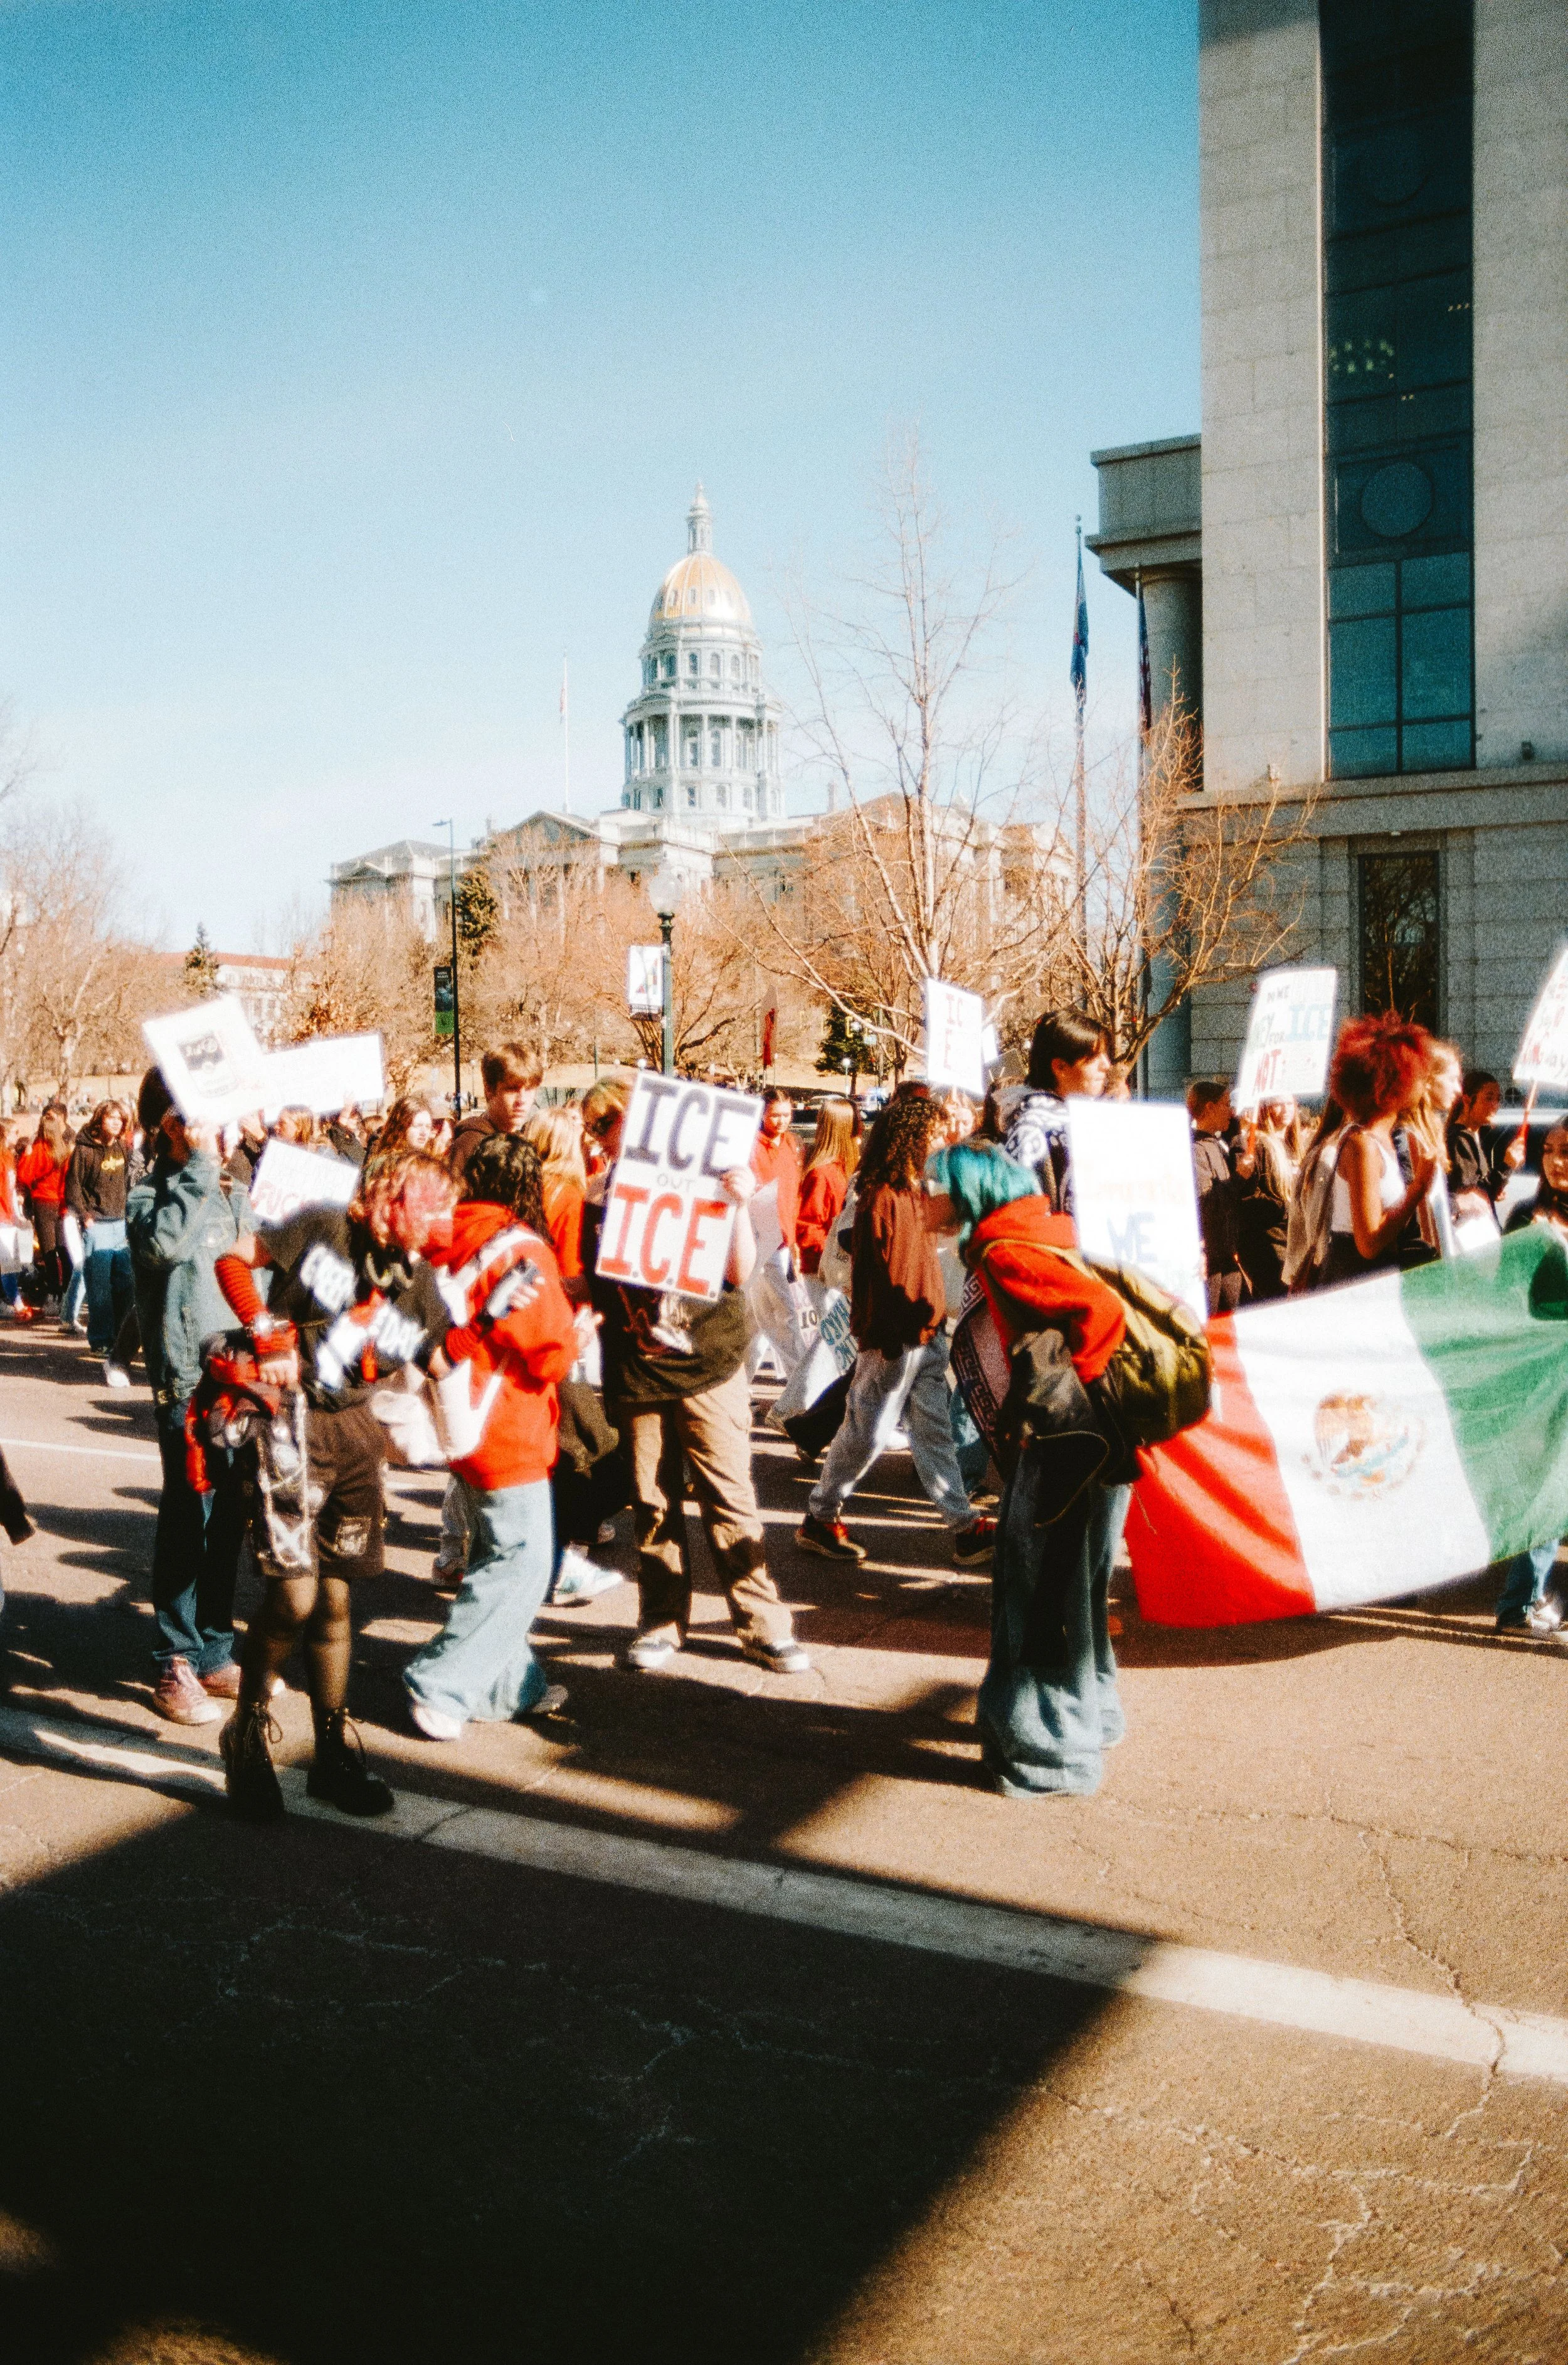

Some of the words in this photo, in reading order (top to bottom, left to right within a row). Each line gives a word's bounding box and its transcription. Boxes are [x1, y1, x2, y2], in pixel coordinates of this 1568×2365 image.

[1285, 1002, 1332, 1042] ICE
[624, 1077, 759, 1178] ICE
[657, 1173, 695, 1191] OUT
[1107, 1211, 1158, 1264] WE
